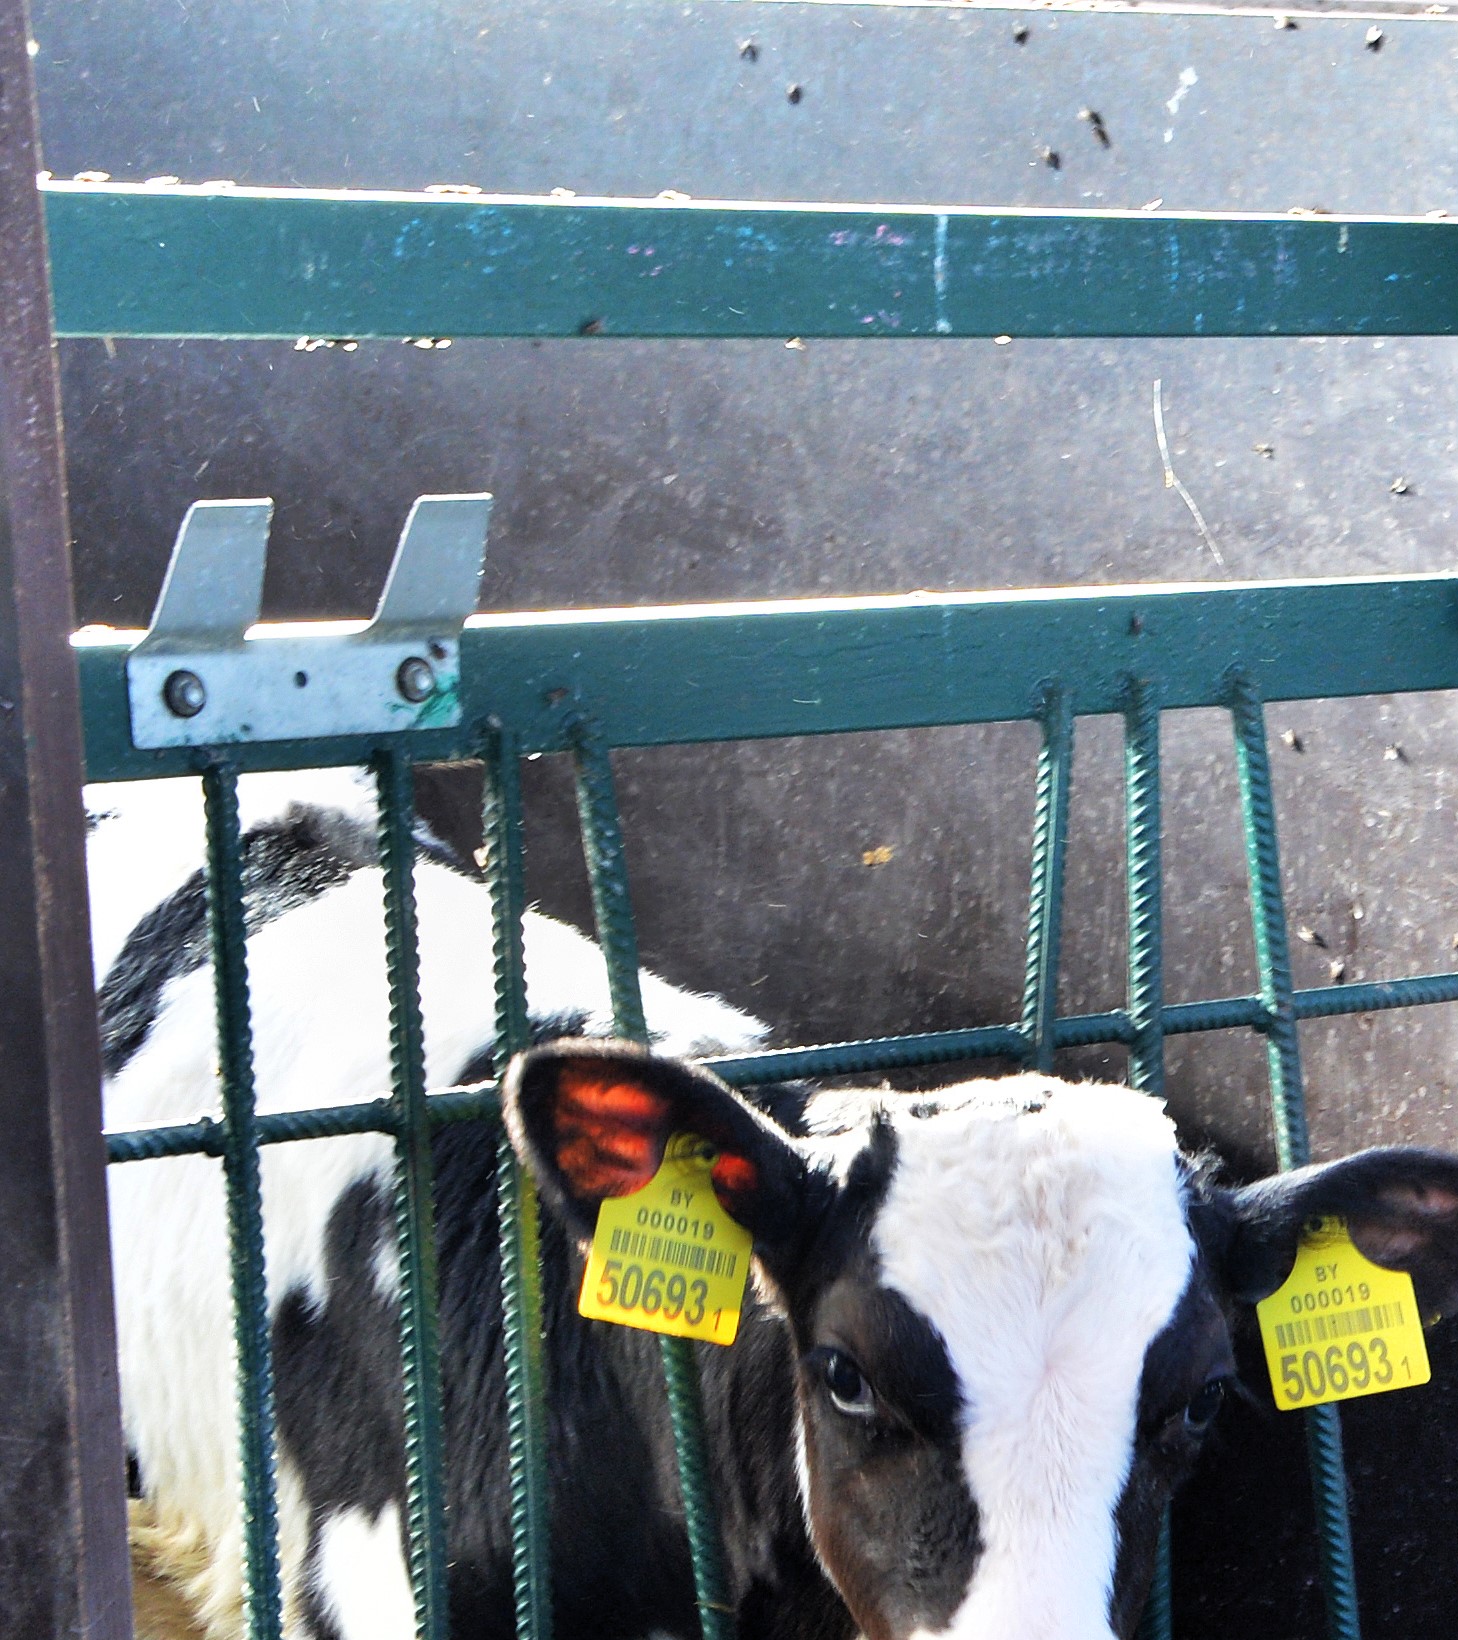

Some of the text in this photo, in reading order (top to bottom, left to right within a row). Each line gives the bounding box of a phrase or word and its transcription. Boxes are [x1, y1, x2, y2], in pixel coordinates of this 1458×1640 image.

[636, 1207, 715, 1241] 000019
[1314, 1263, 1339, 1283] BY
[596, 1258, 723, 1333] 50693 1
[1290, 1282, 1371, 1315] 000019
[1281, 1336, 1413, 1404] 50693 1
